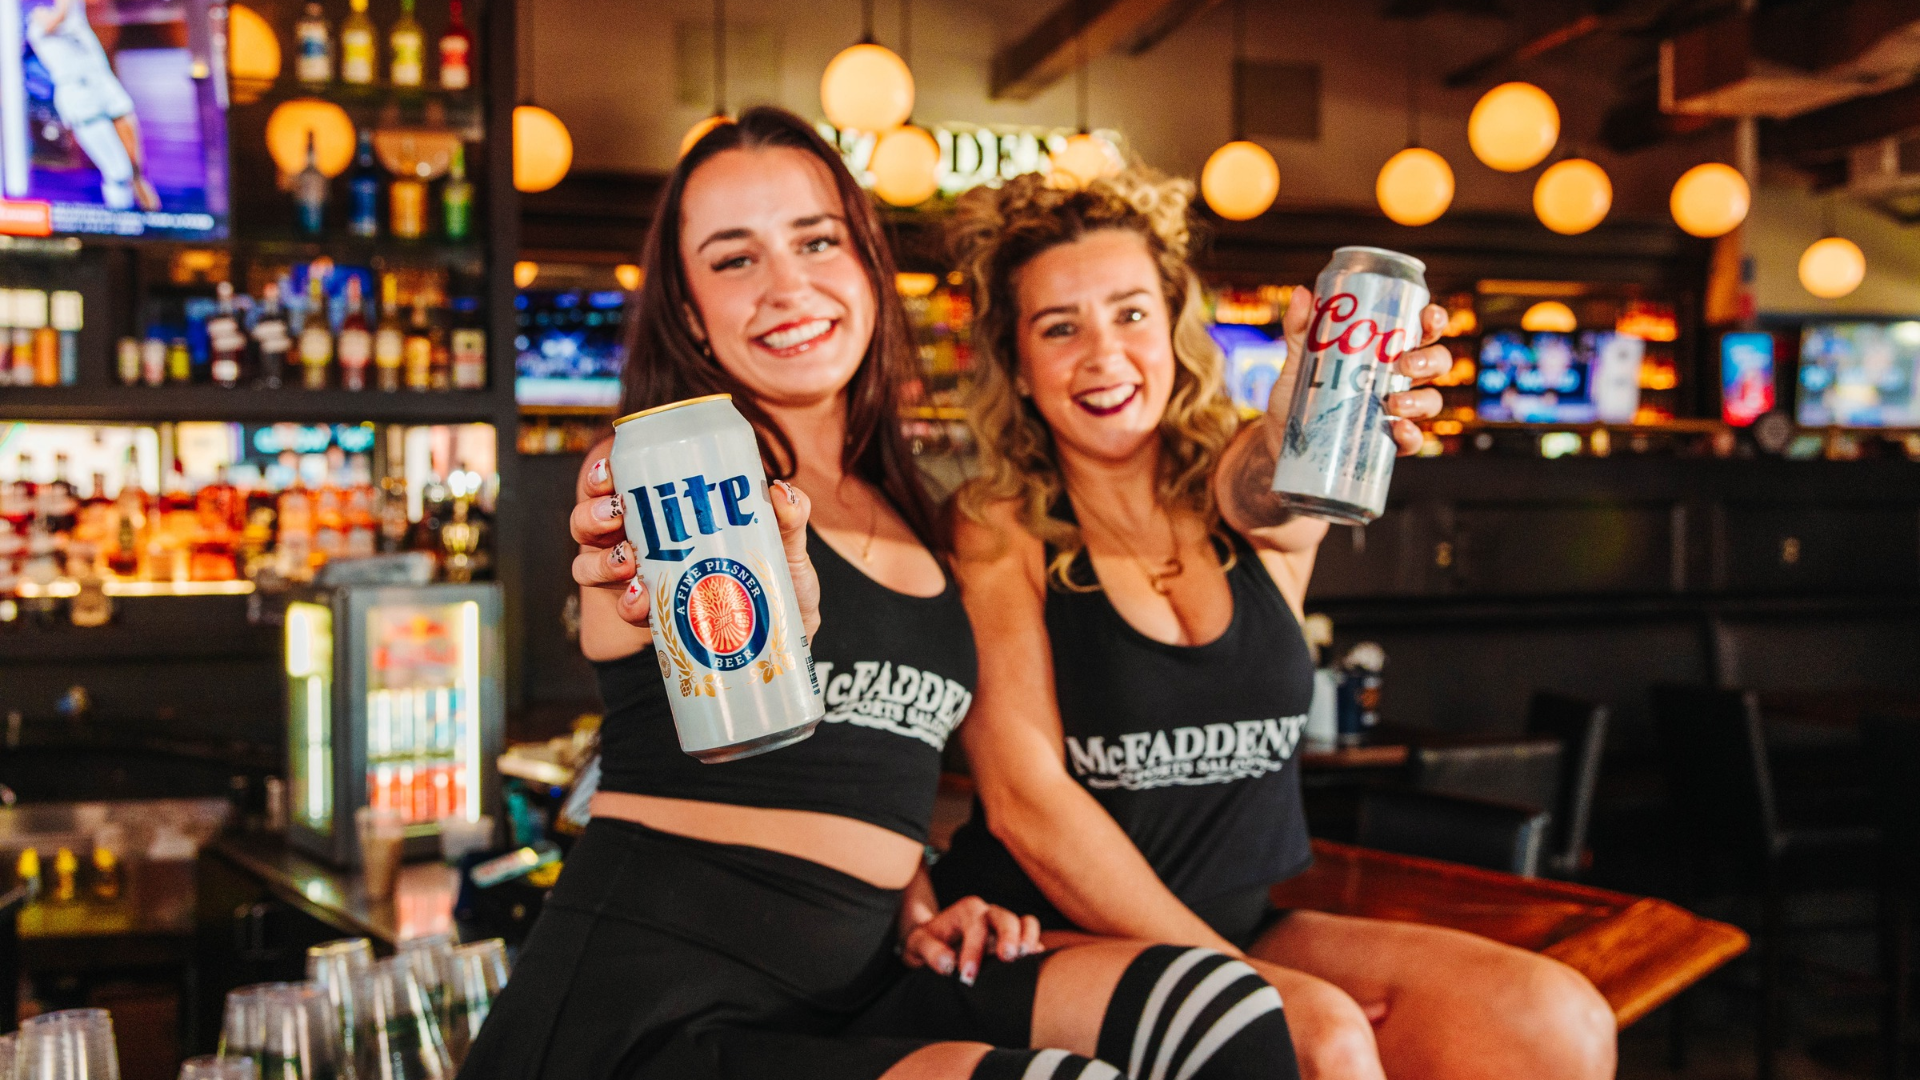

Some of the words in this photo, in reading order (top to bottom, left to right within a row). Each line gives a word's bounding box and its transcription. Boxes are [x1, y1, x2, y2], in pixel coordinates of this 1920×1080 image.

[627, 474, 755, 562] Lite
[677, 567, 702, 601] FINE
[705, 560, 761, 598] PILSNER
[676, 605, 686, 616] A
[714, 648, 755, 668] BEER
